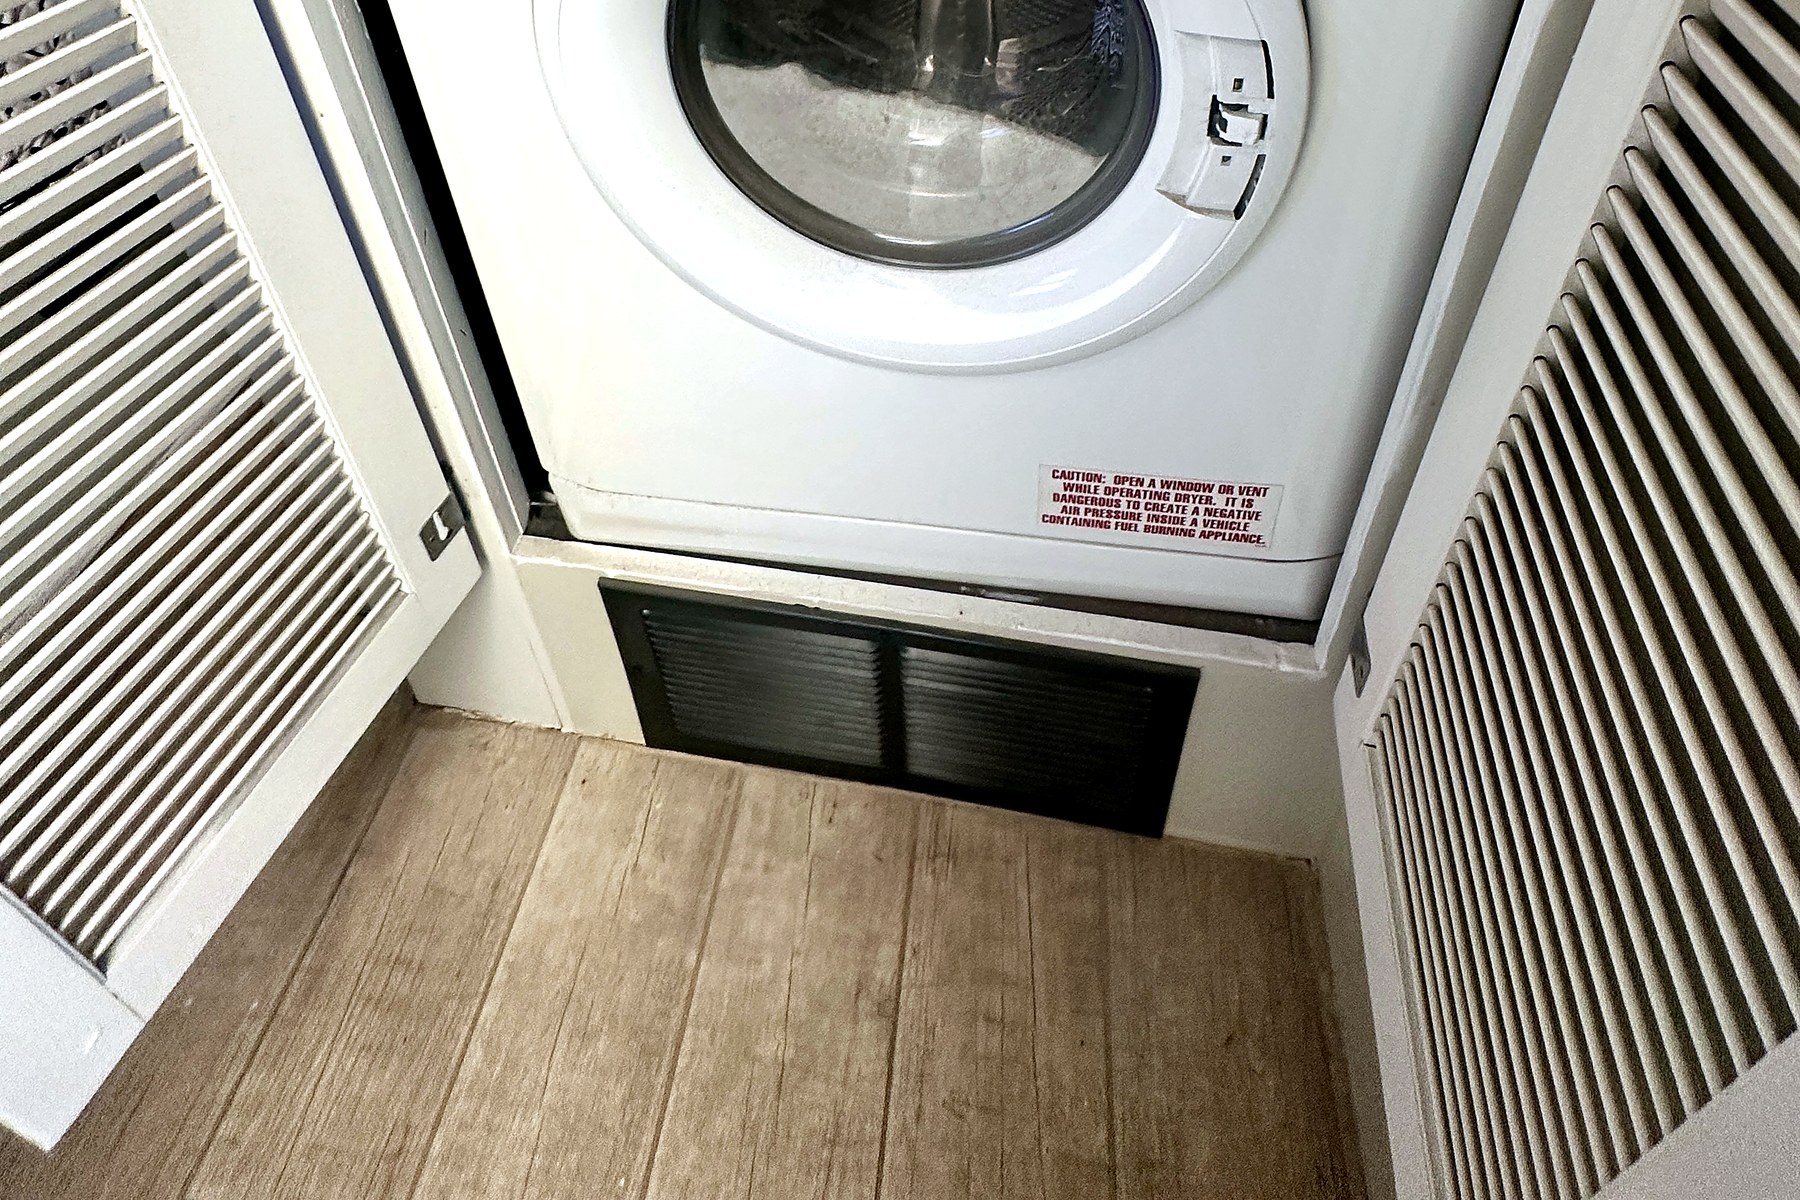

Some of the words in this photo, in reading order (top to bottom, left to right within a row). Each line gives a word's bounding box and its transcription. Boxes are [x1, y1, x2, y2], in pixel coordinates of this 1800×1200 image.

[1052, 469, 1106, 484] CAUTION:
[1114, 475, 1144, 487] OPEN
[1147, 478, 1156, 488] A
[1160, 479, 1215, 493] WINDOW
[1218, 484, 1235, 495] OR
[1238, 485, 1269, 497] VENT
[1062, 482, 1100, 495] WHILE
[1104, 486, 1170, 501] OPERATING
[1174, 492, 1216, 506] DRYER.
[1225, 497, 1237, 506] IT
[1241, 498, 1254, 508] IS
[1052, 493, 1121, 508] DANGEROUS
[1126, 500, 1140, 510] TO
[1144, 501, 1188, 515] CREATE
[1191, 506, 1199, 516] A
[1203, 507, 1262, 521] NEGATIVE
[1060, 505, 1080, 515] AIR
[1084, 507, 1142, 522] PRESSURE
[1147, 513, 1186, 526] INSIDE
[1190, 518, 1198, 527] A
[1203, 518, 1250, 532] VEHICLE
[1042, 514, 1111, 529] CONTAINING
[1114, 521, 1140, 533] FUEL
[1143, 525, 1196, 538] BURNING
[1198, 530, 1266, 544] APPLIANCE.
